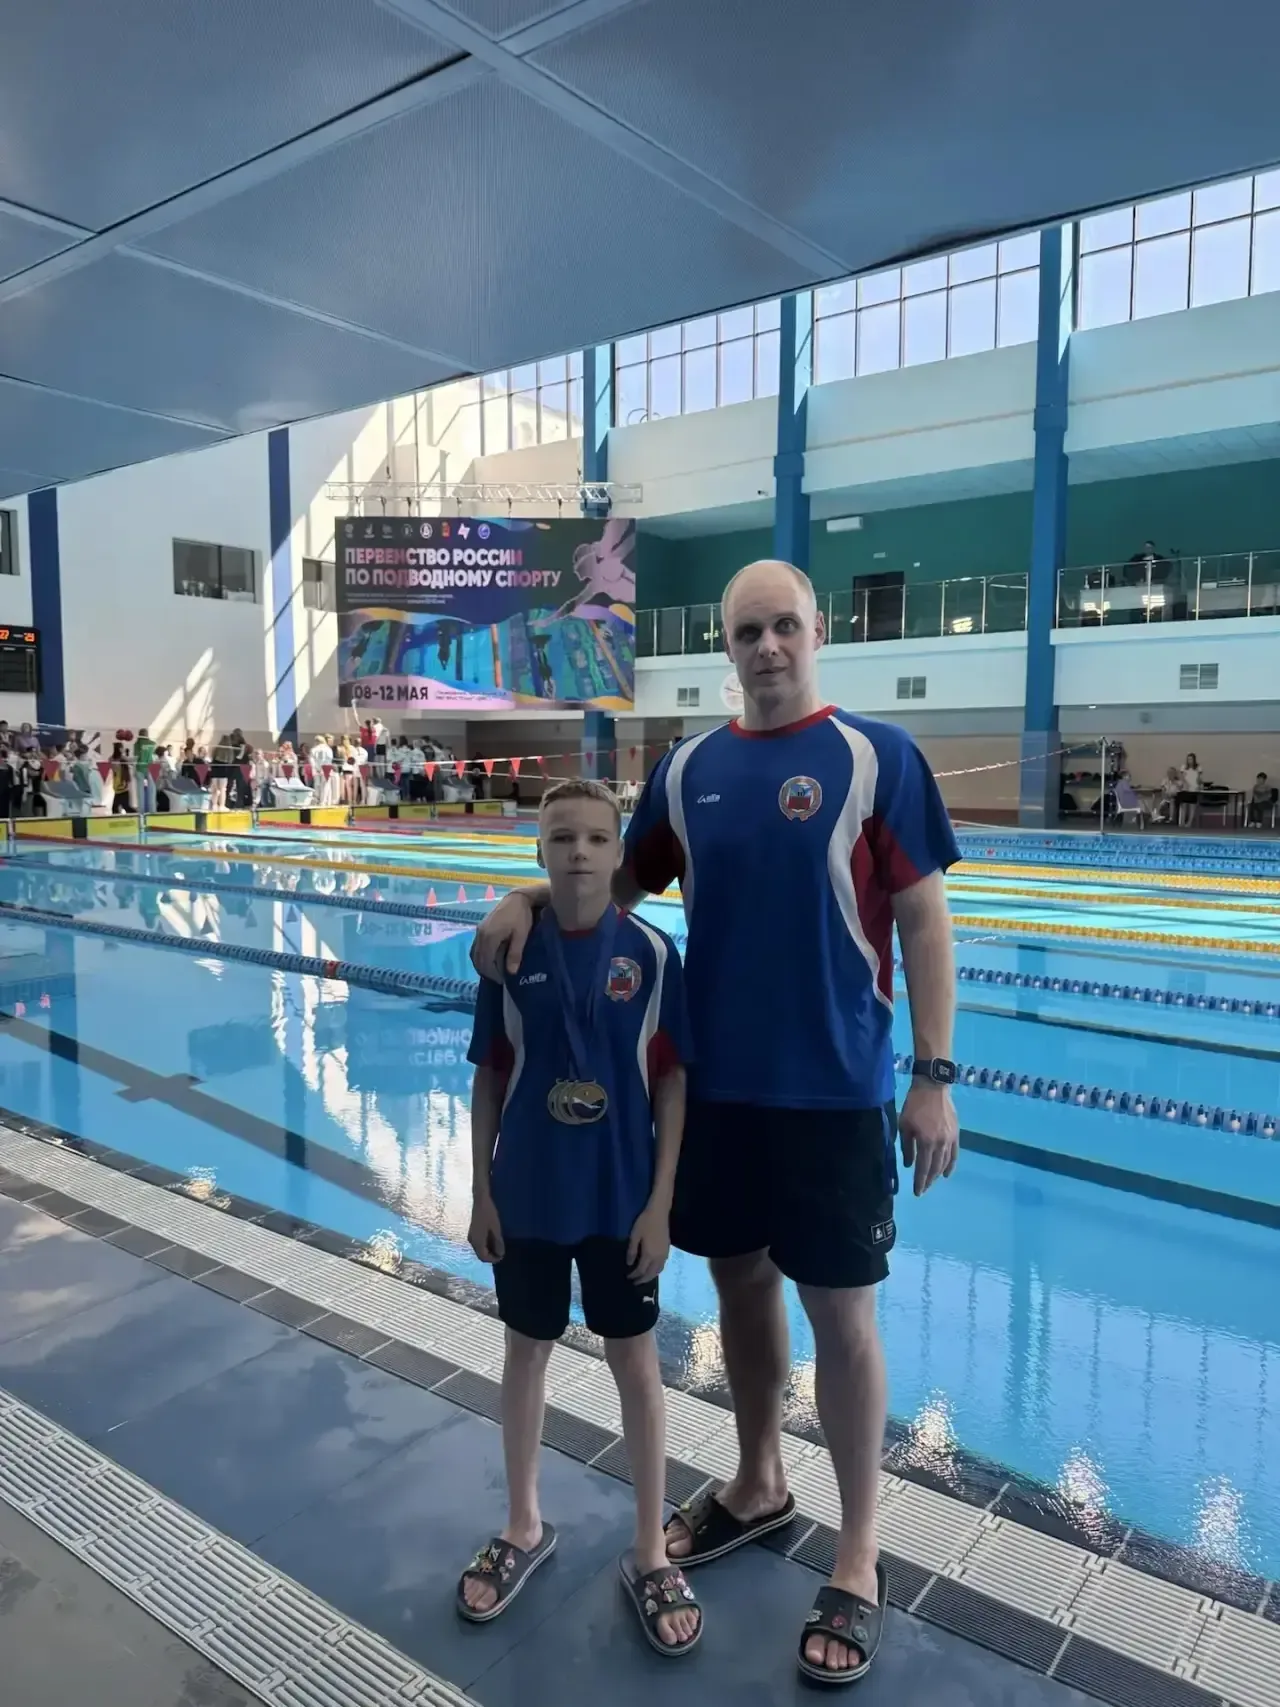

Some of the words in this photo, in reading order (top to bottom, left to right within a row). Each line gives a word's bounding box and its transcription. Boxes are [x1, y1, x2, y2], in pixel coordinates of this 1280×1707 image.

[345, 548, 450, 565] ПЕРВЕНСТВО
[453, 549, 523, 566] РОССИИ
[345, 569, 370, 585] ПО
[373, 569, 493, 589] ПОДВОДНОМУ
[495, 569, 562, 587] СПОРТУ
[397, 685, 429, 701] МАЯ
